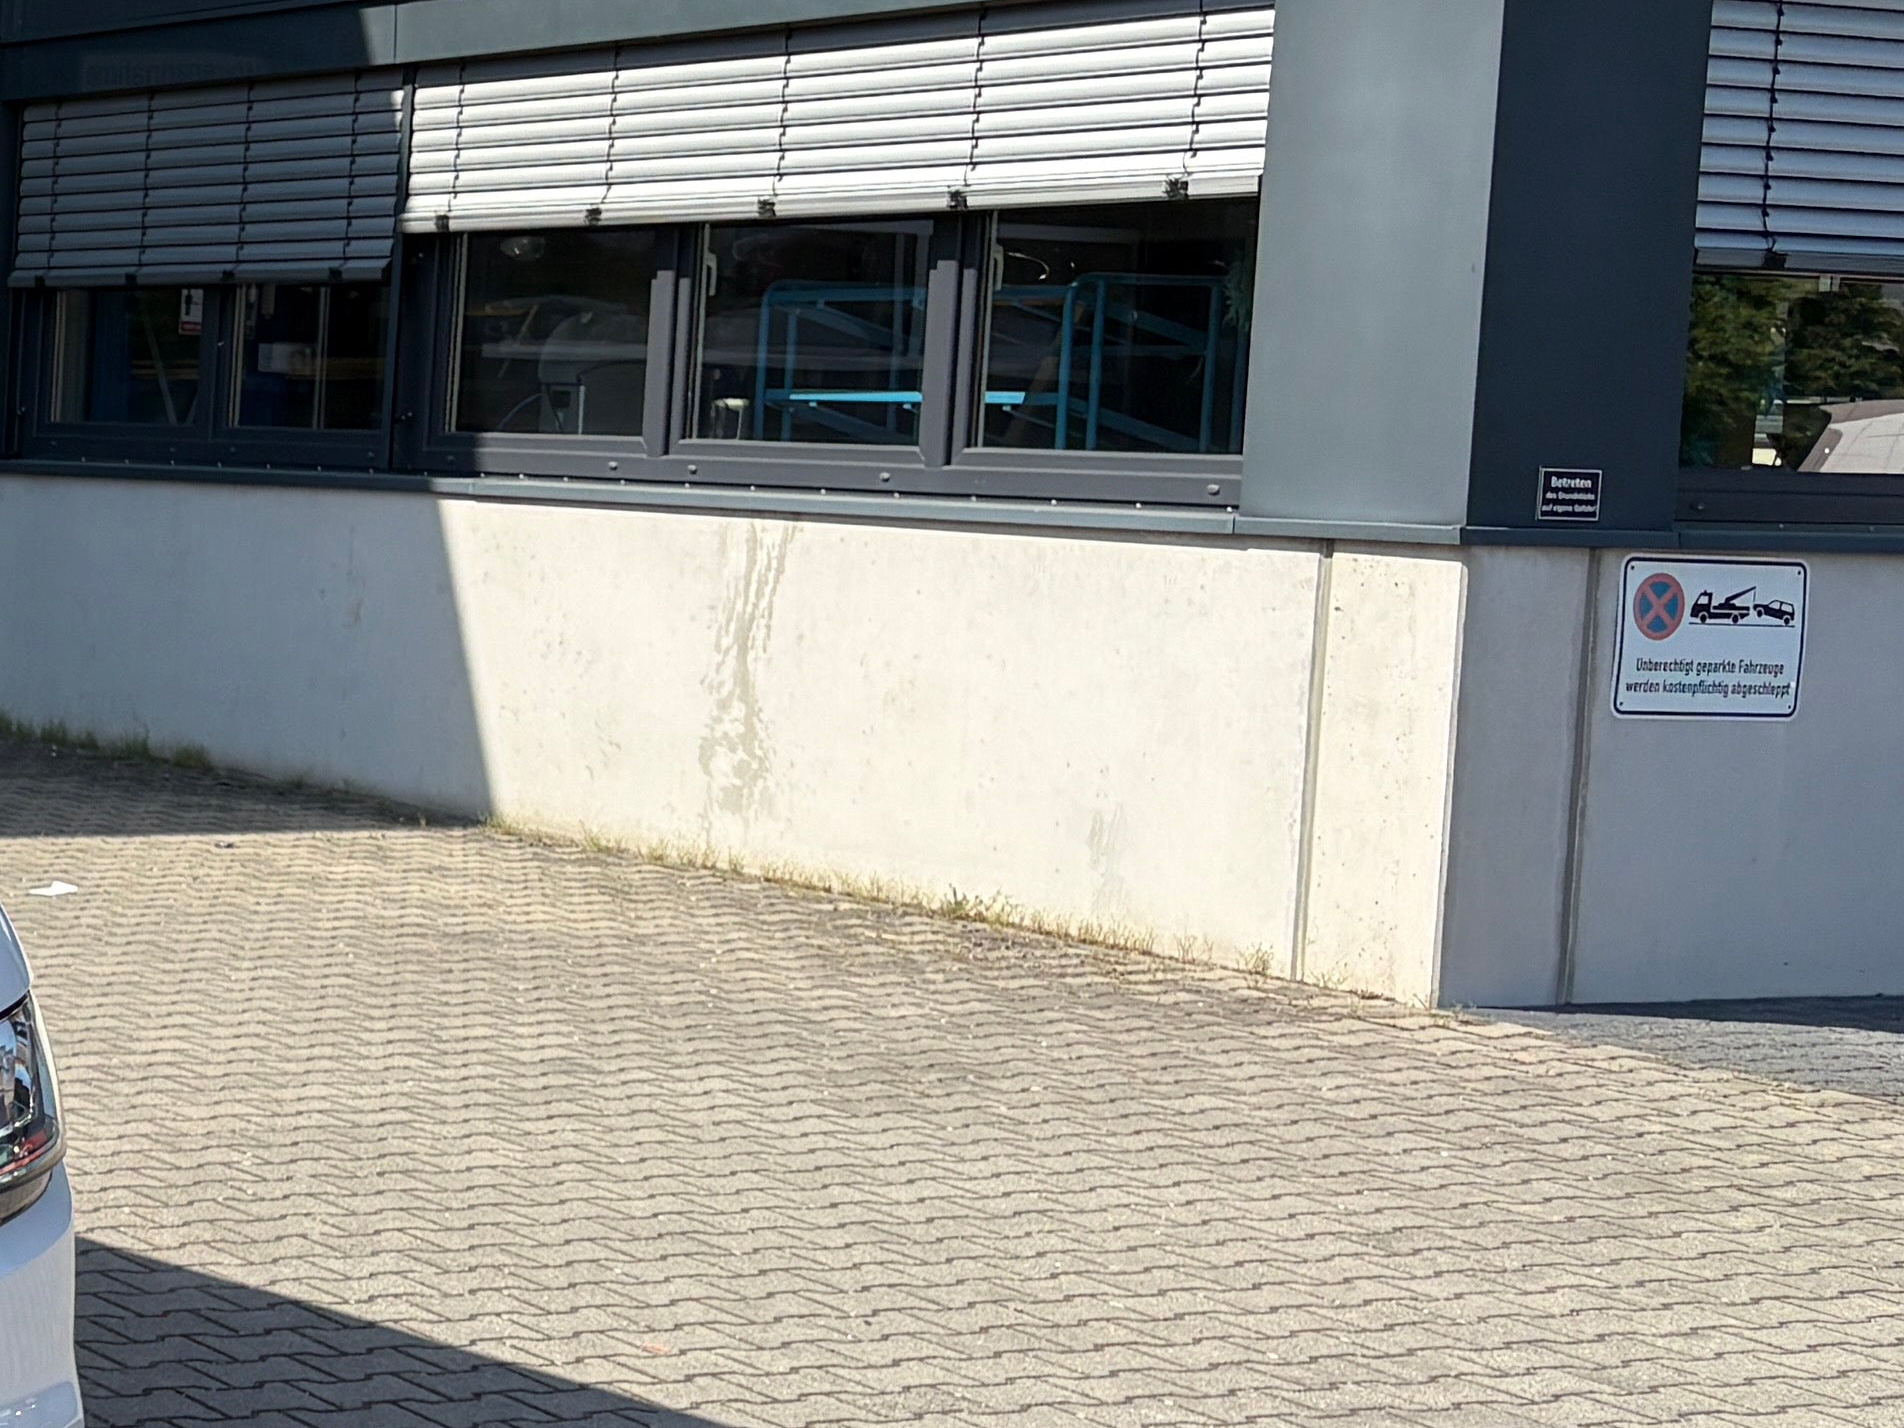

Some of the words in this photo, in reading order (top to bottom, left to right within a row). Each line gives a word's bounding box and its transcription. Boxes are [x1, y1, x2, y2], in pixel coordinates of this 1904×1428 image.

[1695, 659, 1737, 677] geparkte
[1738, 659, 1785, 678] Fahrzeuge
[1625, 679, 1660, 693] werden
